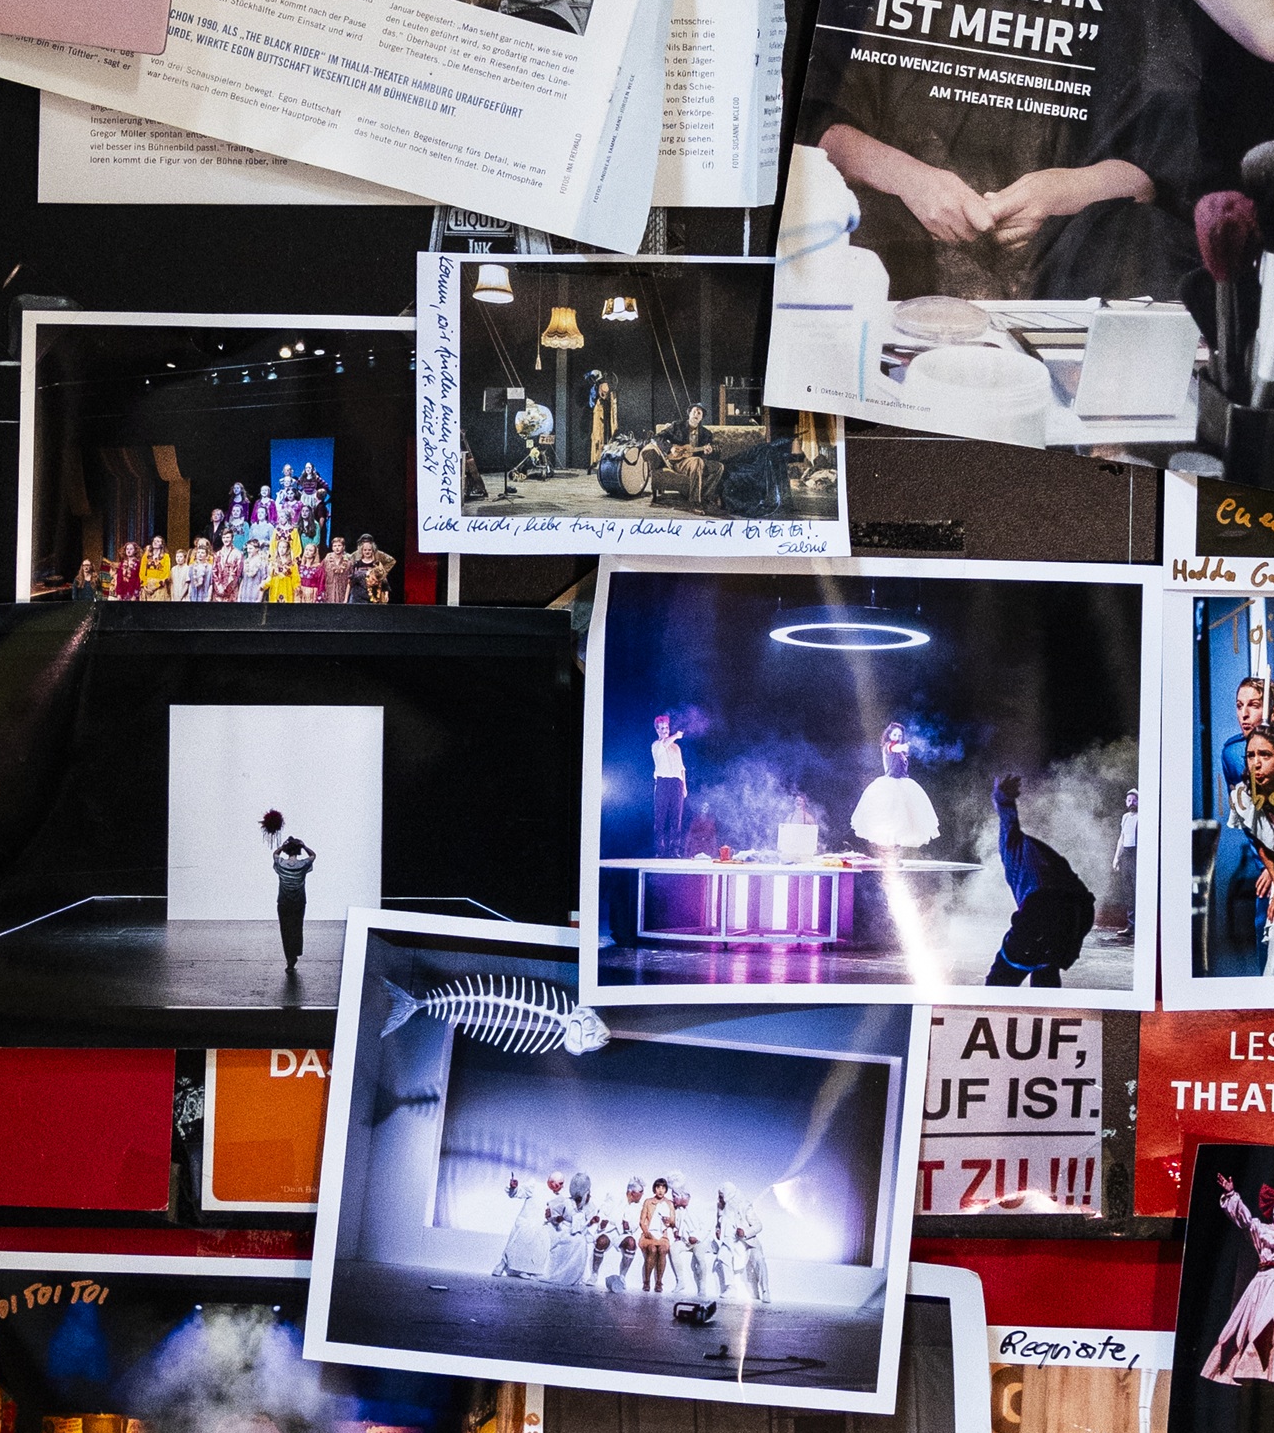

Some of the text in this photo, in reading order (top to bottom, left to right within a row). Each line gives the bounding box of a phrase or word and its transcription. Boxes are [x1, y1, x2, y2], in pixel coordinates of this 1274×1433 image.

[949, 2, 1099, 60] MEHR”
[166, 24, 458, 118] URDE, WIRKTE EGON BUTTSCHAFT WESENTLICH AM BÜHNENBILD MIT.
[167, 8, 523, 120] CHON 1990, ALS „THE BLACK RIDER“ IM THALIA-THEATER HAMBURG URAUFGEFÜHRT
[849, 47, 1092, 97] MARCO WENZIG IST MASKENBILDNER
[929, 85, 1088, 121] AM THEATER LÜNEBURG
[820, 387, 844, 396] Oktober
[844, 391, 857, 399] 2021
[270, 1049, 333, 1078] DA
[961, 1017, 1087, 1069] AUF,
[1007, 1077, 1099, 1119] IST.
[71, 1279, 109, 1304] TOI
